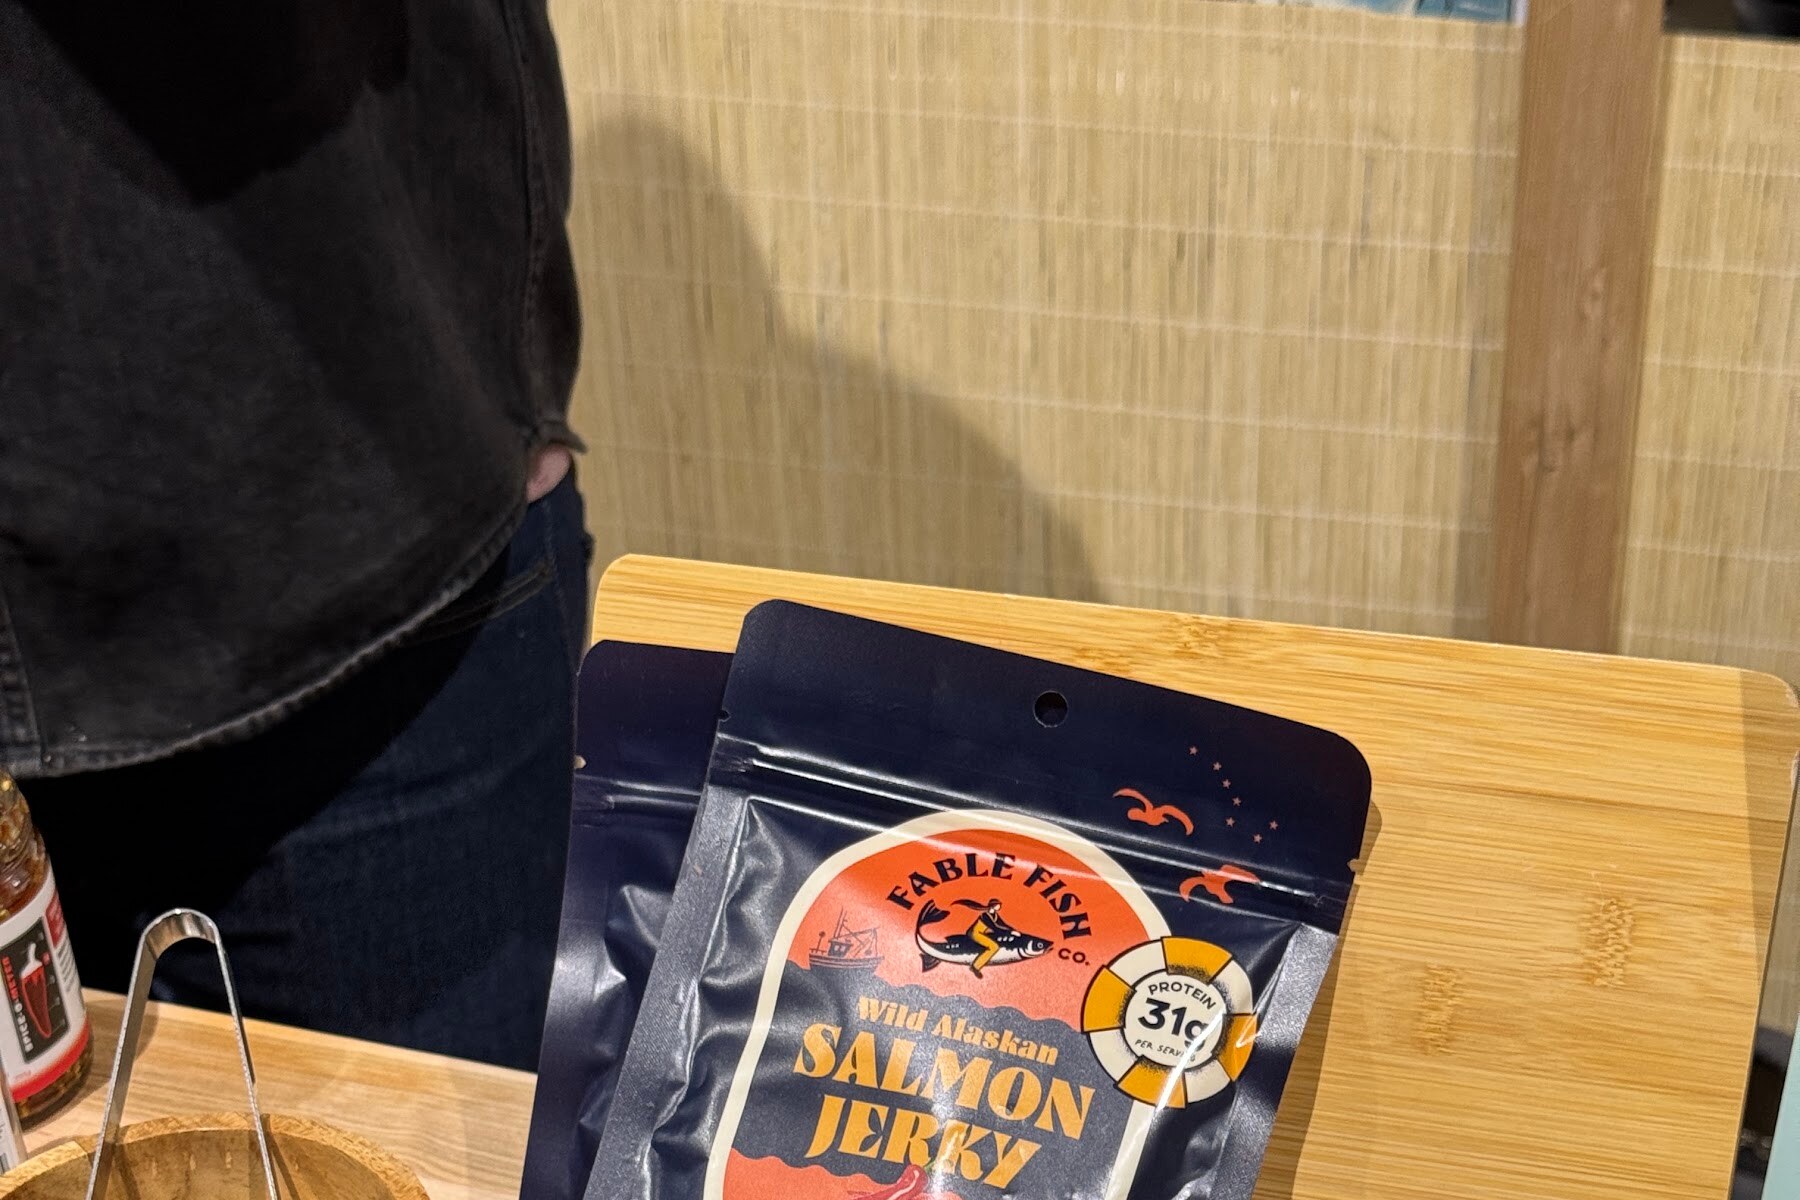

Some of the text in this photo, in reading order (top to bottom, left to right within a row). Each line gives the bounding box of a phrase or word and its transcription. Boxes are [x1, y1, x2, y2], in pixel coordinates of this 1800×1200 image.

[886, 852, 1092, 966] FABLE FISH CO.
[1138, 997, 1210, 1051] 31g
[1148, 981, 1217, 1010] PROTEIN
[858, 996, 1060, 1066] Wild Alaskan
[1135, 1039, 1196, 1062] PER SERVIG
[793, 1022, 1096, 1141] SALMON
[804, 1094, 1043, 1189] JERKY
